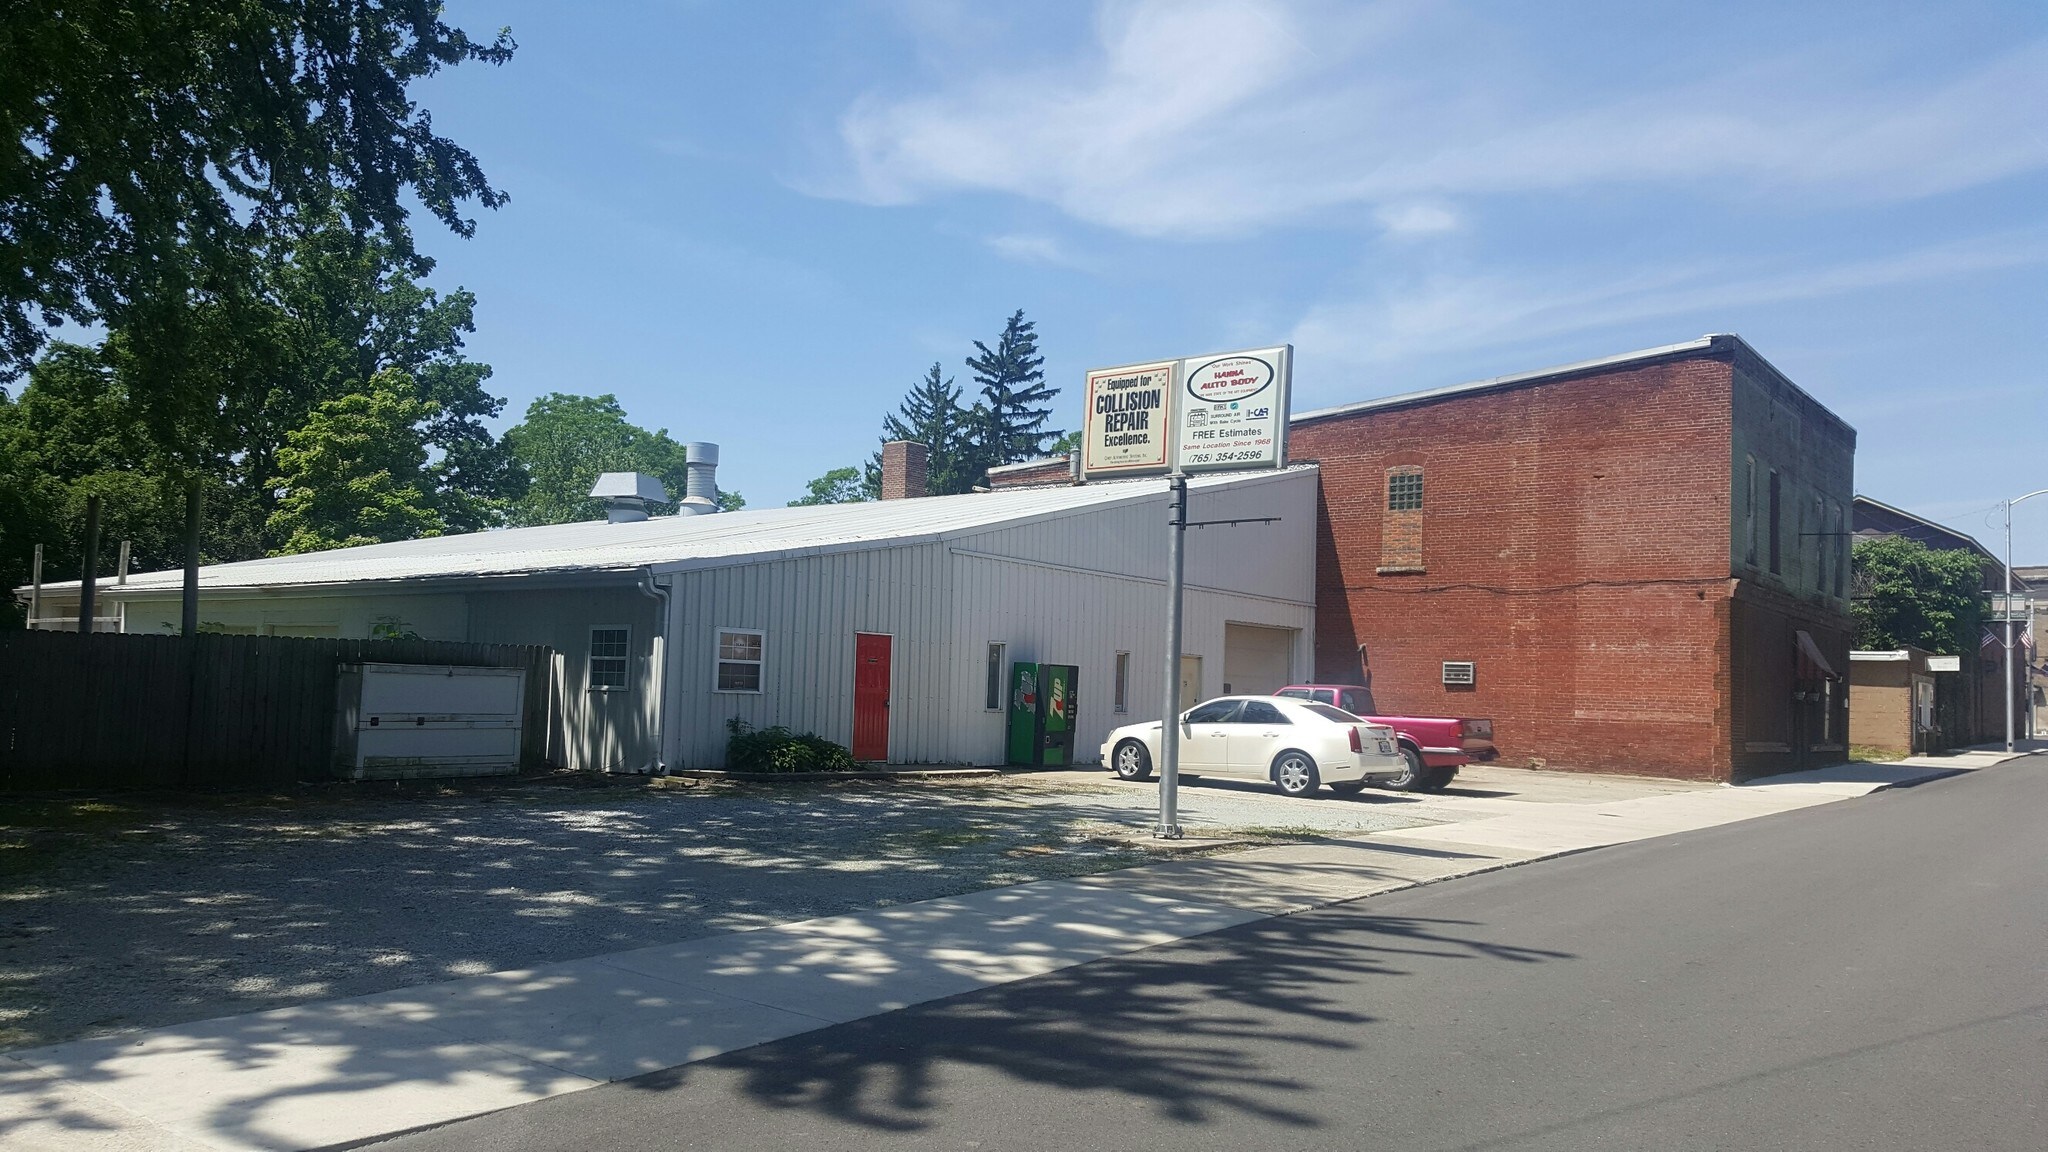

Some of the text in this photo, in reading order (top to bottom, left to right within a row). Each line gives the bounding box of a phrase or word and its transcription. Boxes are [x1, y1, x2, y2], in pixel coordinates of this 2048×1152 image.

[1214, 369, 1244, 379] HANNA
[1107, 375, 1152, 391] Equipped for
[1200, 376, 1259, 390] AUTO BODY
[1096, 389, 1161, 414] COLLISION
[1105, 411, 1149, 433] REPAIR
[1104, 433, 1150, 447] Excellence.
[1192, 427, 1262, 440] FREE Estimates
[1188, 450, 1263, 463] (765) 354-2596
